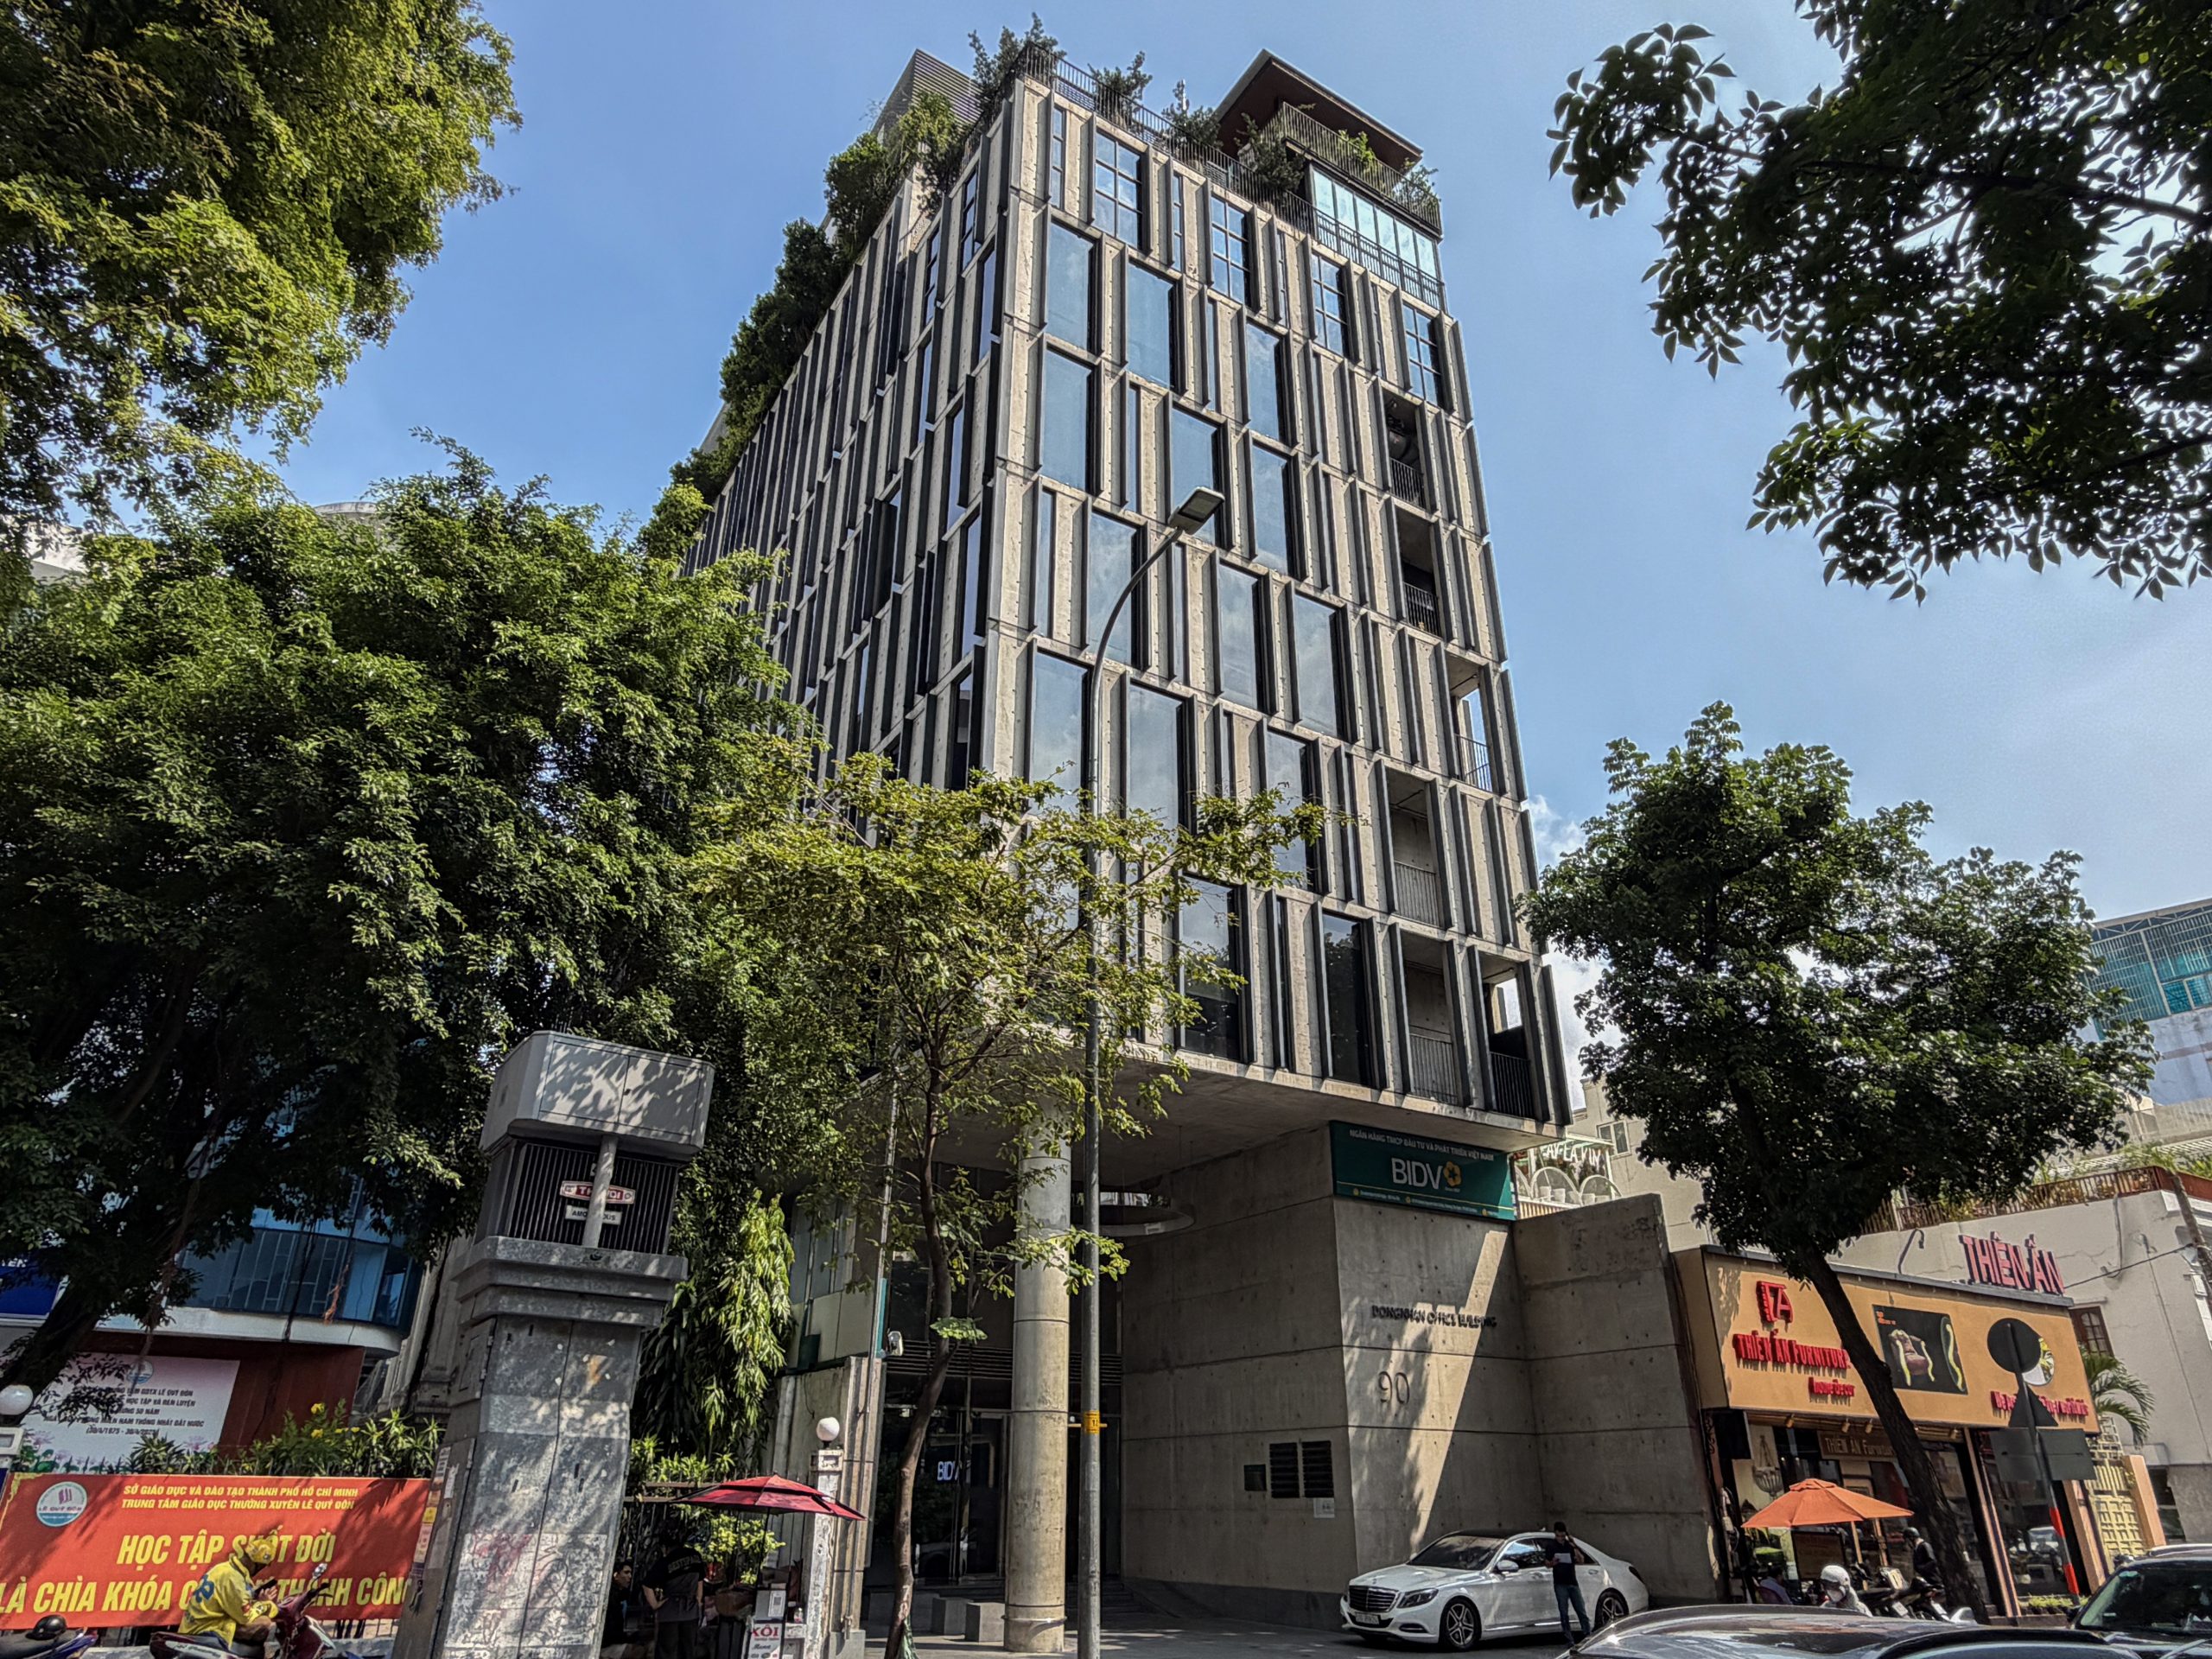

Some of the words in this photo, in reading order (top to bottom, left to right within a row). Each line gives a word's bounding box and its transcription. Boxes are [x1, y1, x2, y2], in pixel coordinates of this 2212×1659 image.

[1391, 1158, 1443, 1190] BIDV
[1958, 1231, 2031, 1290] THIÊN
[1427, 1312, 1456, 1327] OFFICE
[1732, 1330, 1772, 1362] THIÊN
[1378, 1370, 1410, 1404] 90
[122, 1499, 156, 1509] TRUNG
[181, 1497, 206, 1509] GIÁO
[269, 1498, 300, 1510] XUYÊN
[302, 1498, 315, 1510] LÊ
[124, 1483, 138, 1495] SỞ
[140, 1484, 164, 1496] GIÁO
[166, 1485, 188, 1497] DỤC
[189, 1484, 202, 1496] VÀ
[226, 1486, 245, 1497] TẠO
[248, 1485, 278, 1497] THÀNH
[316, 1485, 332, 1497] CHÍ
[334, 1488, 359, 1497] MINH
[117, 1535, 172, 1571] HỌC
[177, 1529, 225, 1570] TẬP
[294, 1528, 337, 1563] ĐỜI
[33, 1575, 97, 1614] CHÌA
[102, 1574, 173, 1612] KHÓA
[753, 1624, 779, 1637] XÔI
